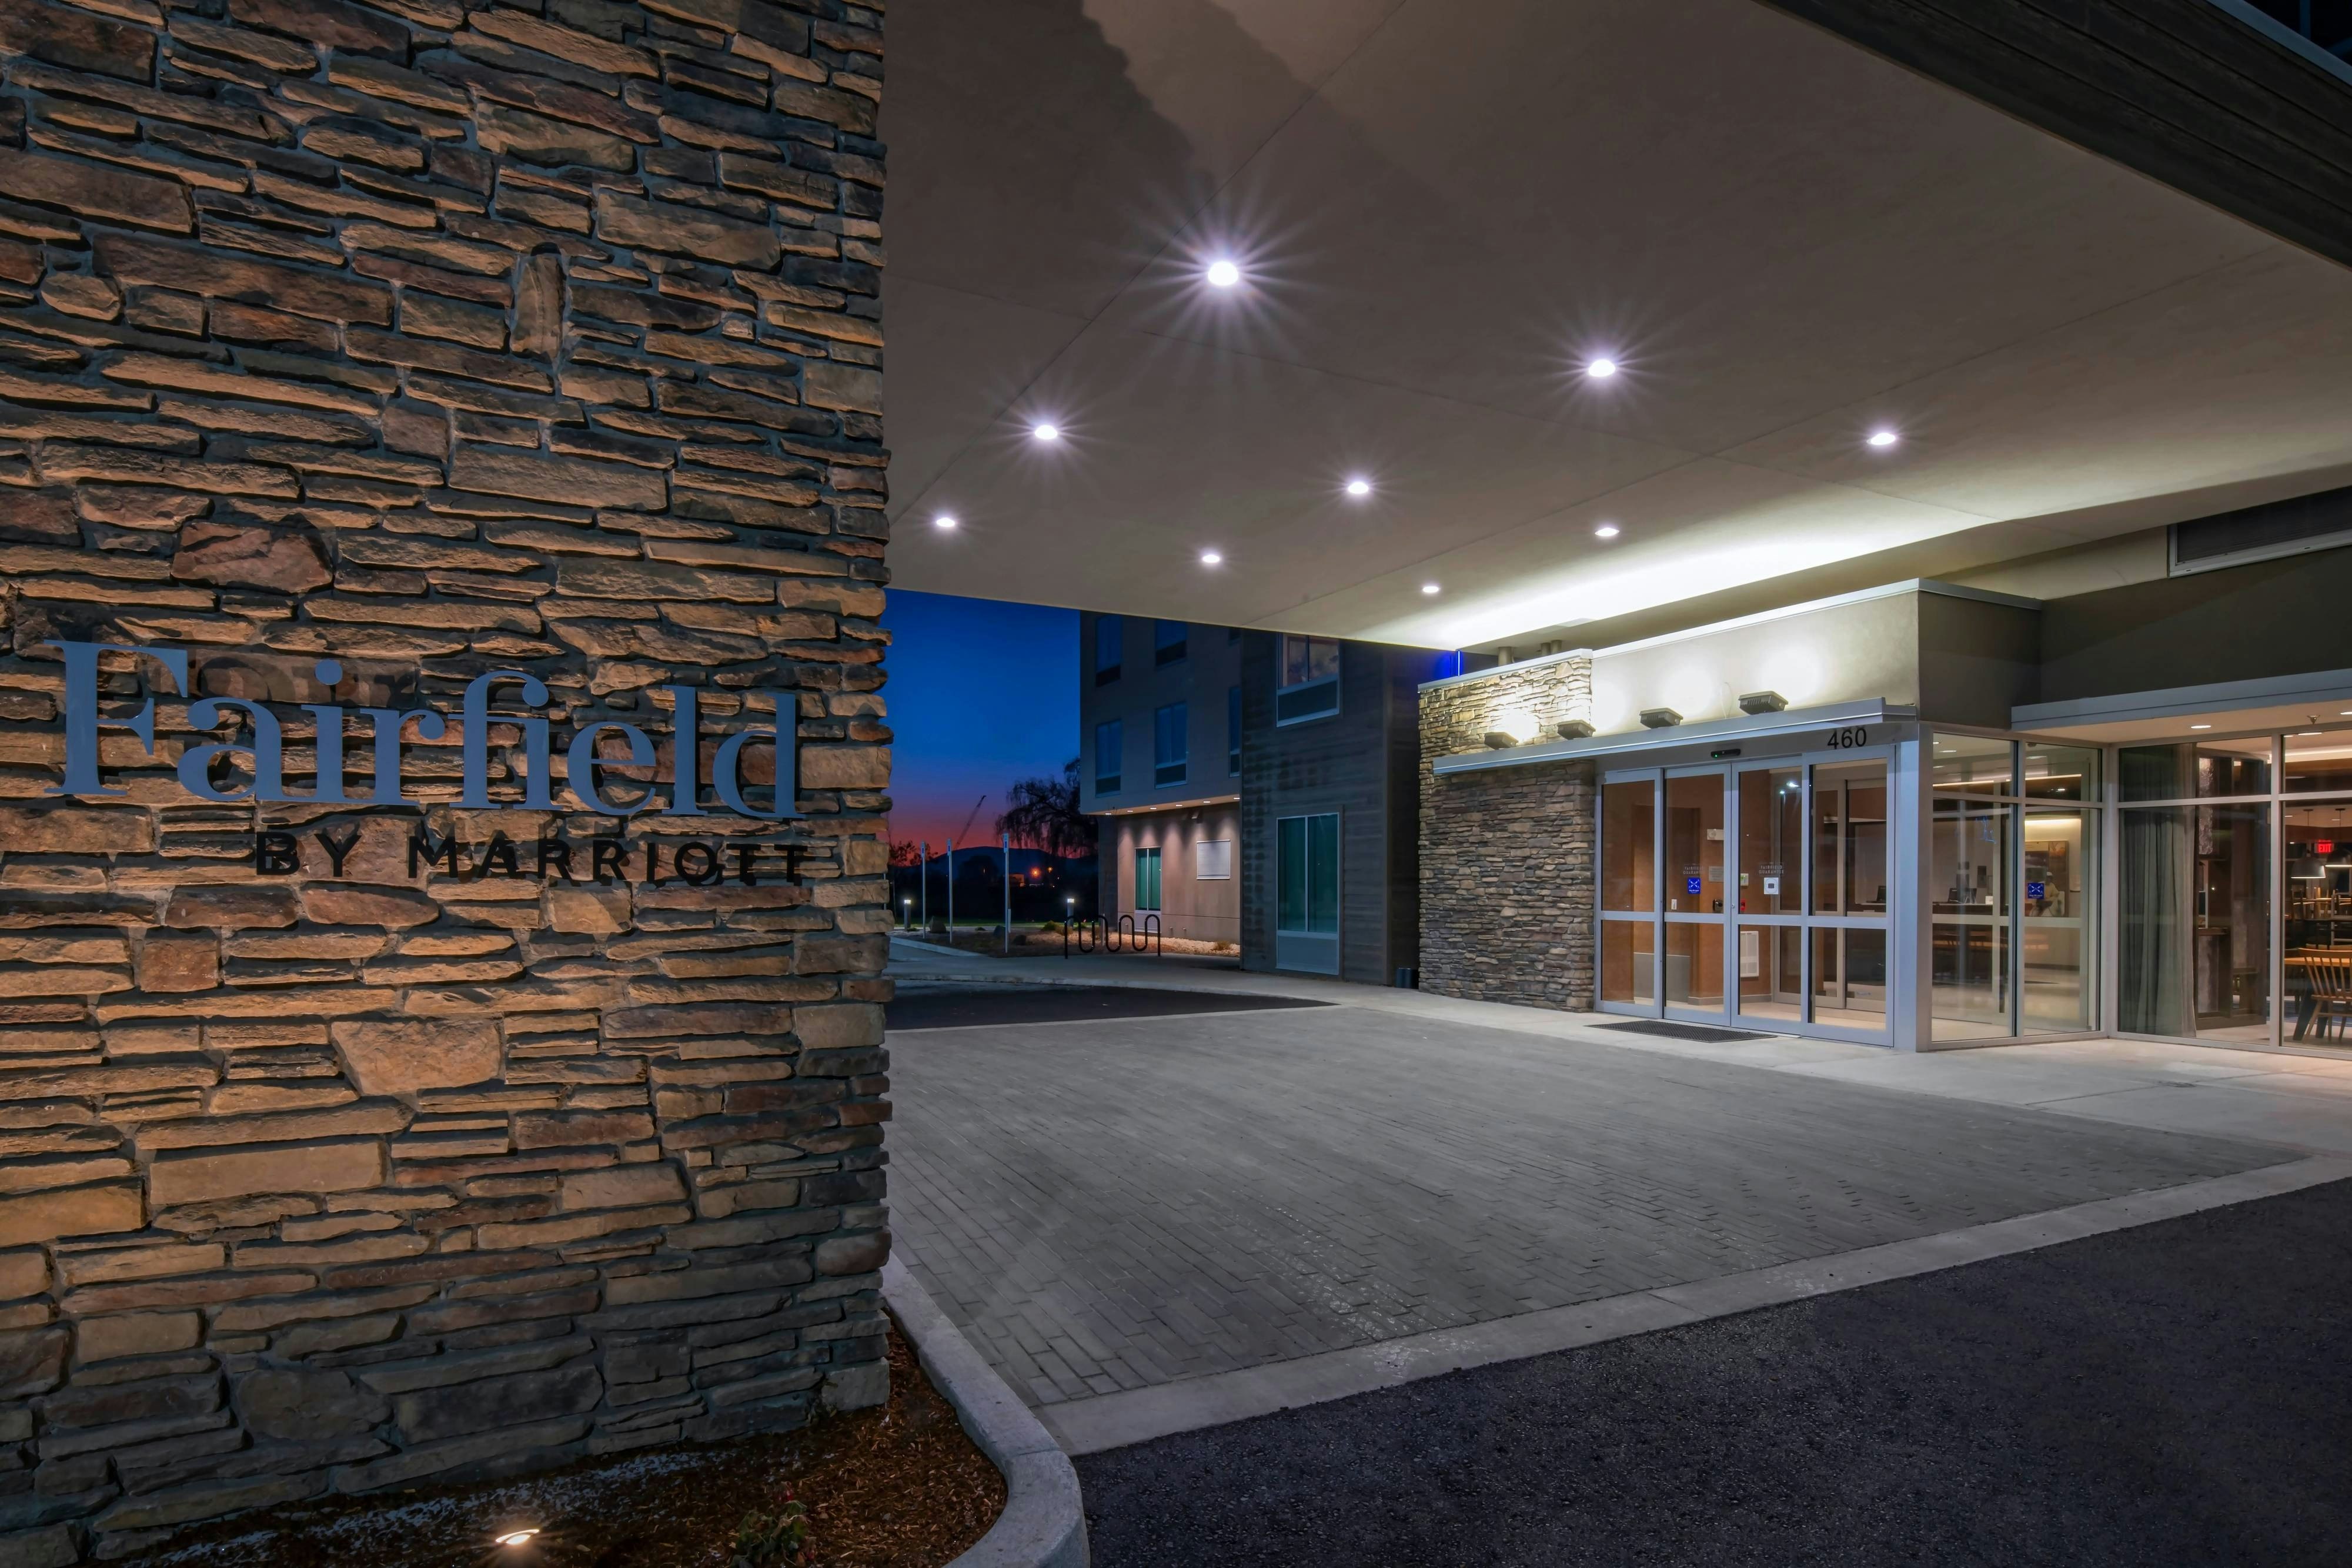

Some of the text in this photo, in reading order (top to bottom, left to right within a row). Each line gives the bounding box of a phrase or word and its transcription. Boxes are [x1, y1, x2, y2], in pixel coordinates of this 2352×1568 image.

[44, 639, 806, 818] Fairfield
[1827, 728, 1867, 750] 460
[256, 831, 808, 886] BY MARRIOTT
[2318, 843, 2333, 852] EXIT
